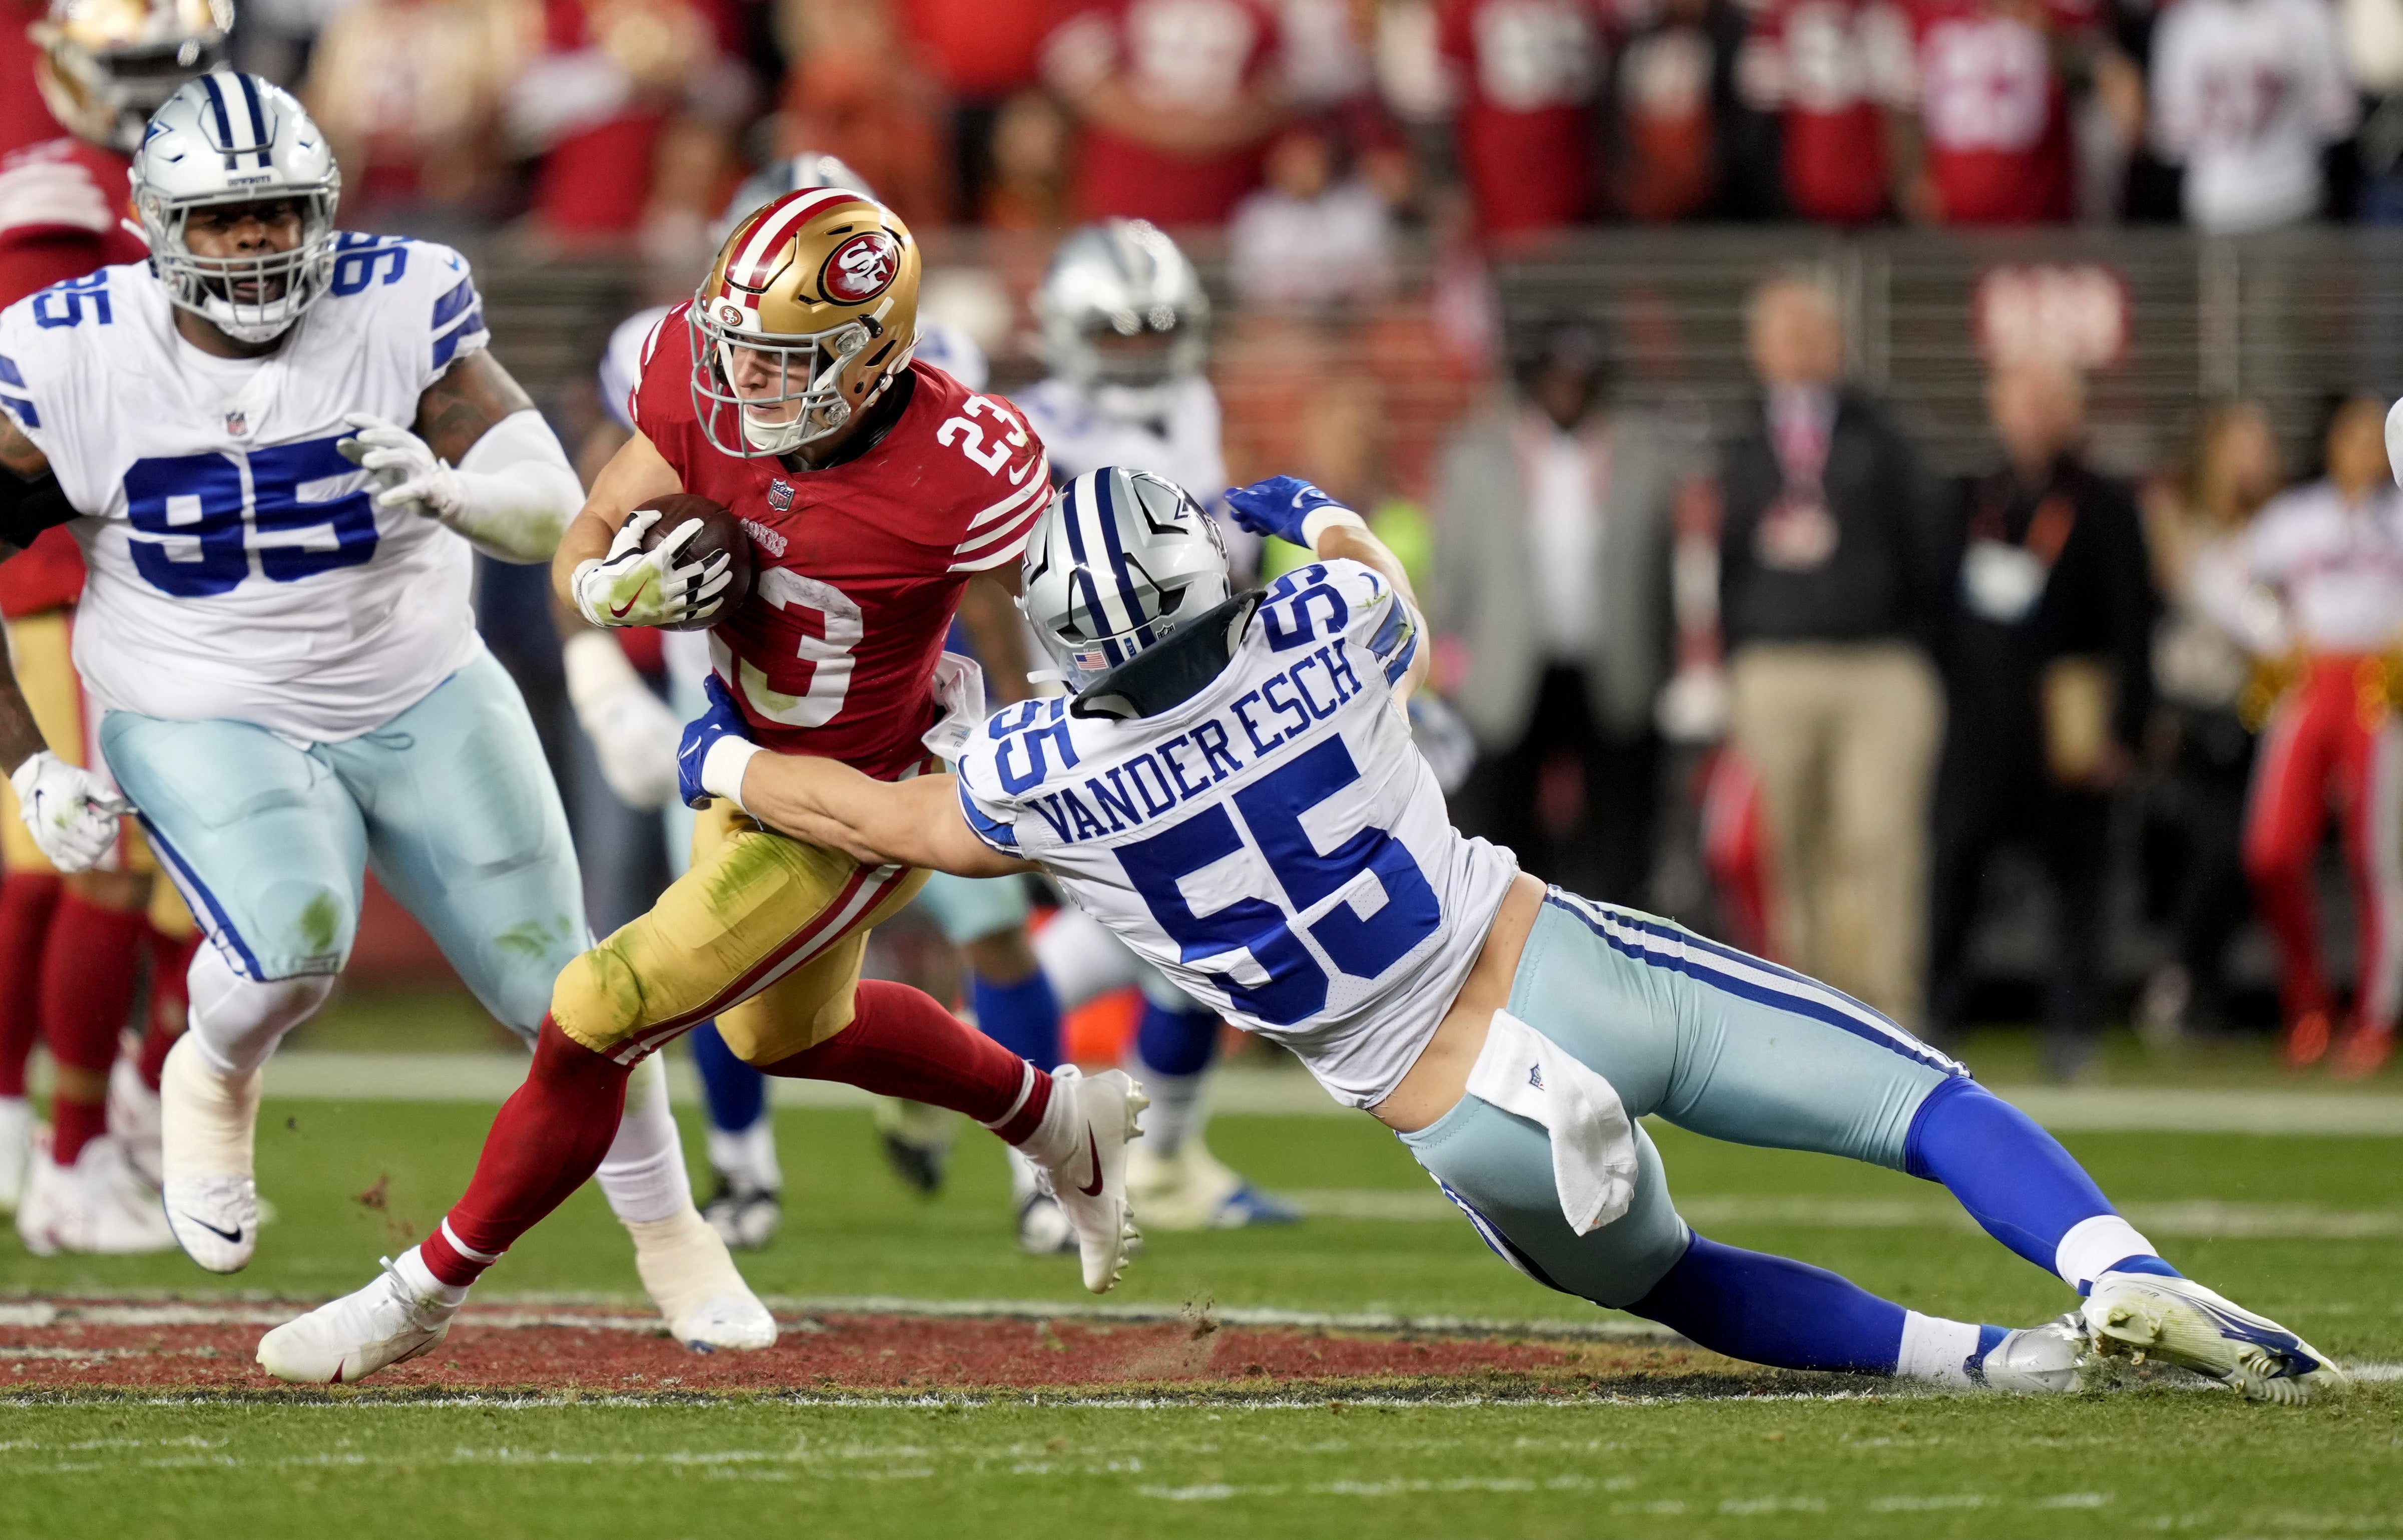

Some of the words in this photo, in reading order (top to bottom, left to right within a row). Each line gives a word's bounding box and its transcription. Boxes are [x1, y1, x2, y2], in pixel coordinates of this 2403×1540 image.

[839, 240, 890, 294] SF
[937, 395, 1029, 477] 23
[124, 428, 379, 597] 95
[706, 565, 864, 727] 3
[1257, 564, 1348, 653] 55
[988, 694, 1080, 796] 55
[1024, 719, 1243, 844] VANDER
[1230, 637, 1363, 758] ESCH
[1112, 732, 1440, 1025] 55
